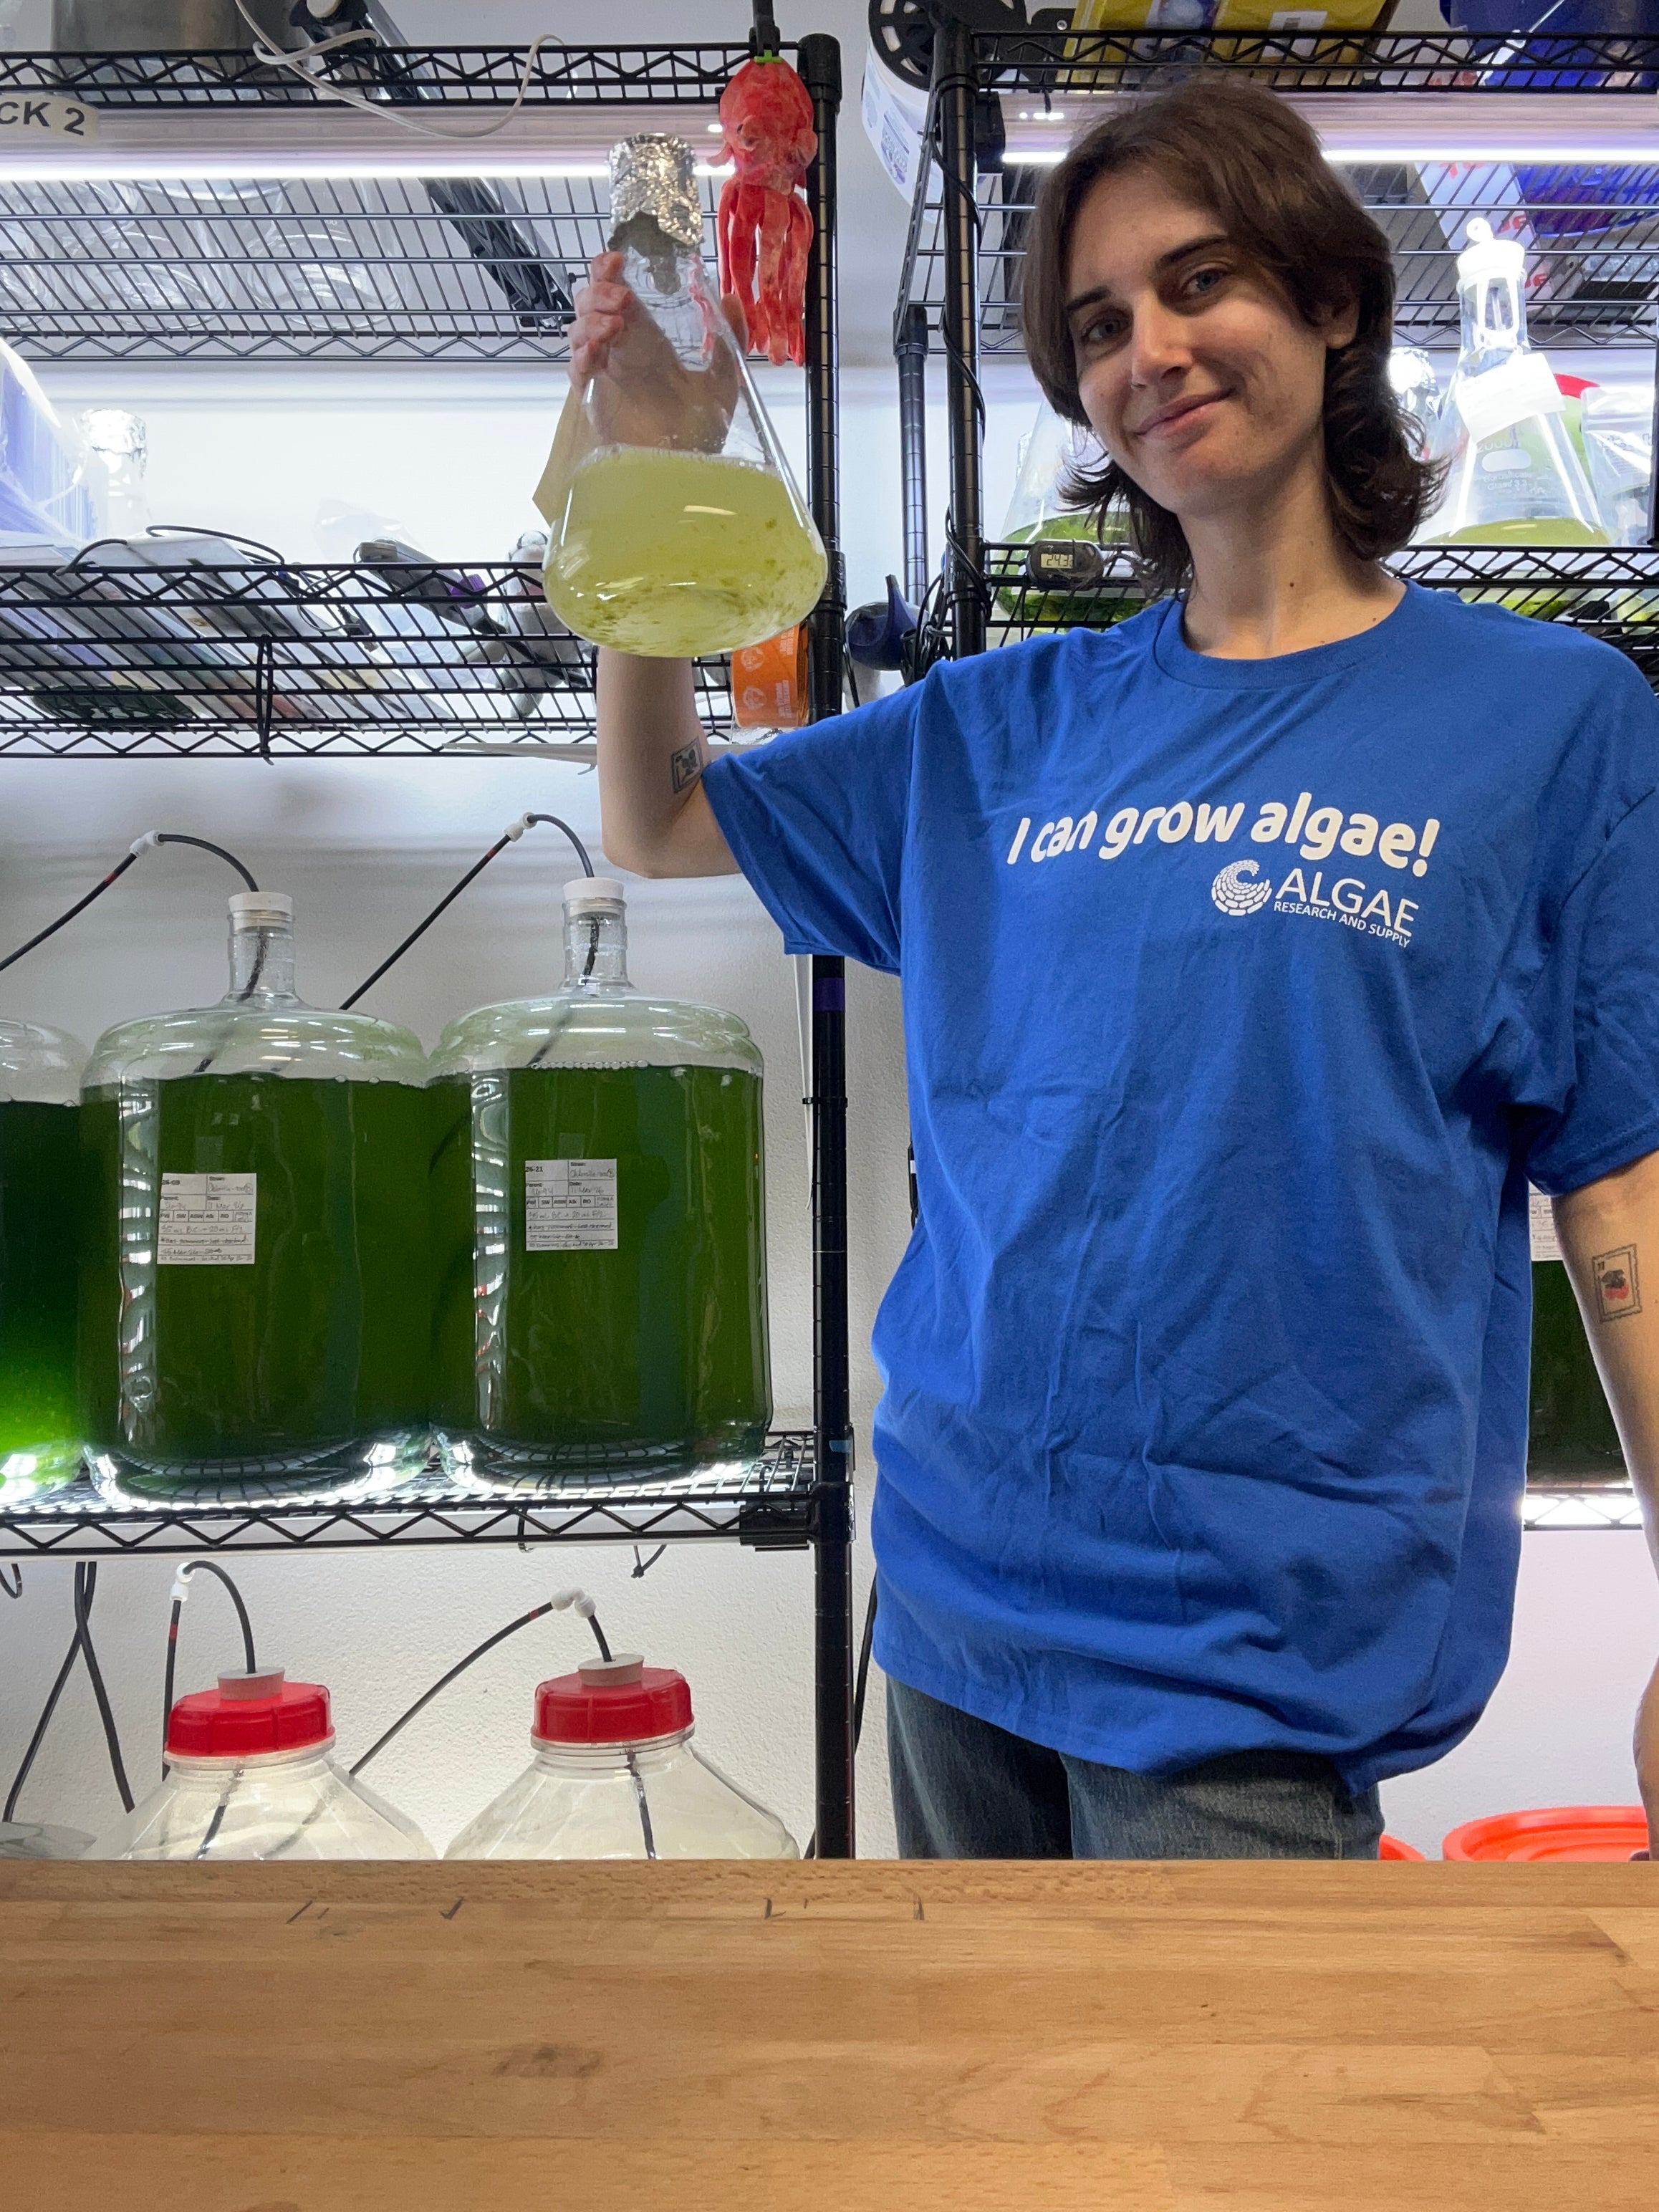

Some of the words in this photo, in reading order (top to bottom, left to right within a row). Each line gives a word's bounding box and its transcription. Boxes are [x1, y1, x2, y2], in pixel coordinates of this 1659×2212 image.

[64, 107, 85, 135] 2
[1007, 817, 1031, 864] I
[1030, 811, 1097, 862] can
[1098, 801, 1245, 860] grow
[1251, 792, 1441, 877] algae!
[1274, 901, 1337, 920] RESEARCH
[1338, 913, 1367, 931] AND
[1367, 923, 1410, 948] SUPPLY
[1275, 867, 1419, 938] ALGAE
